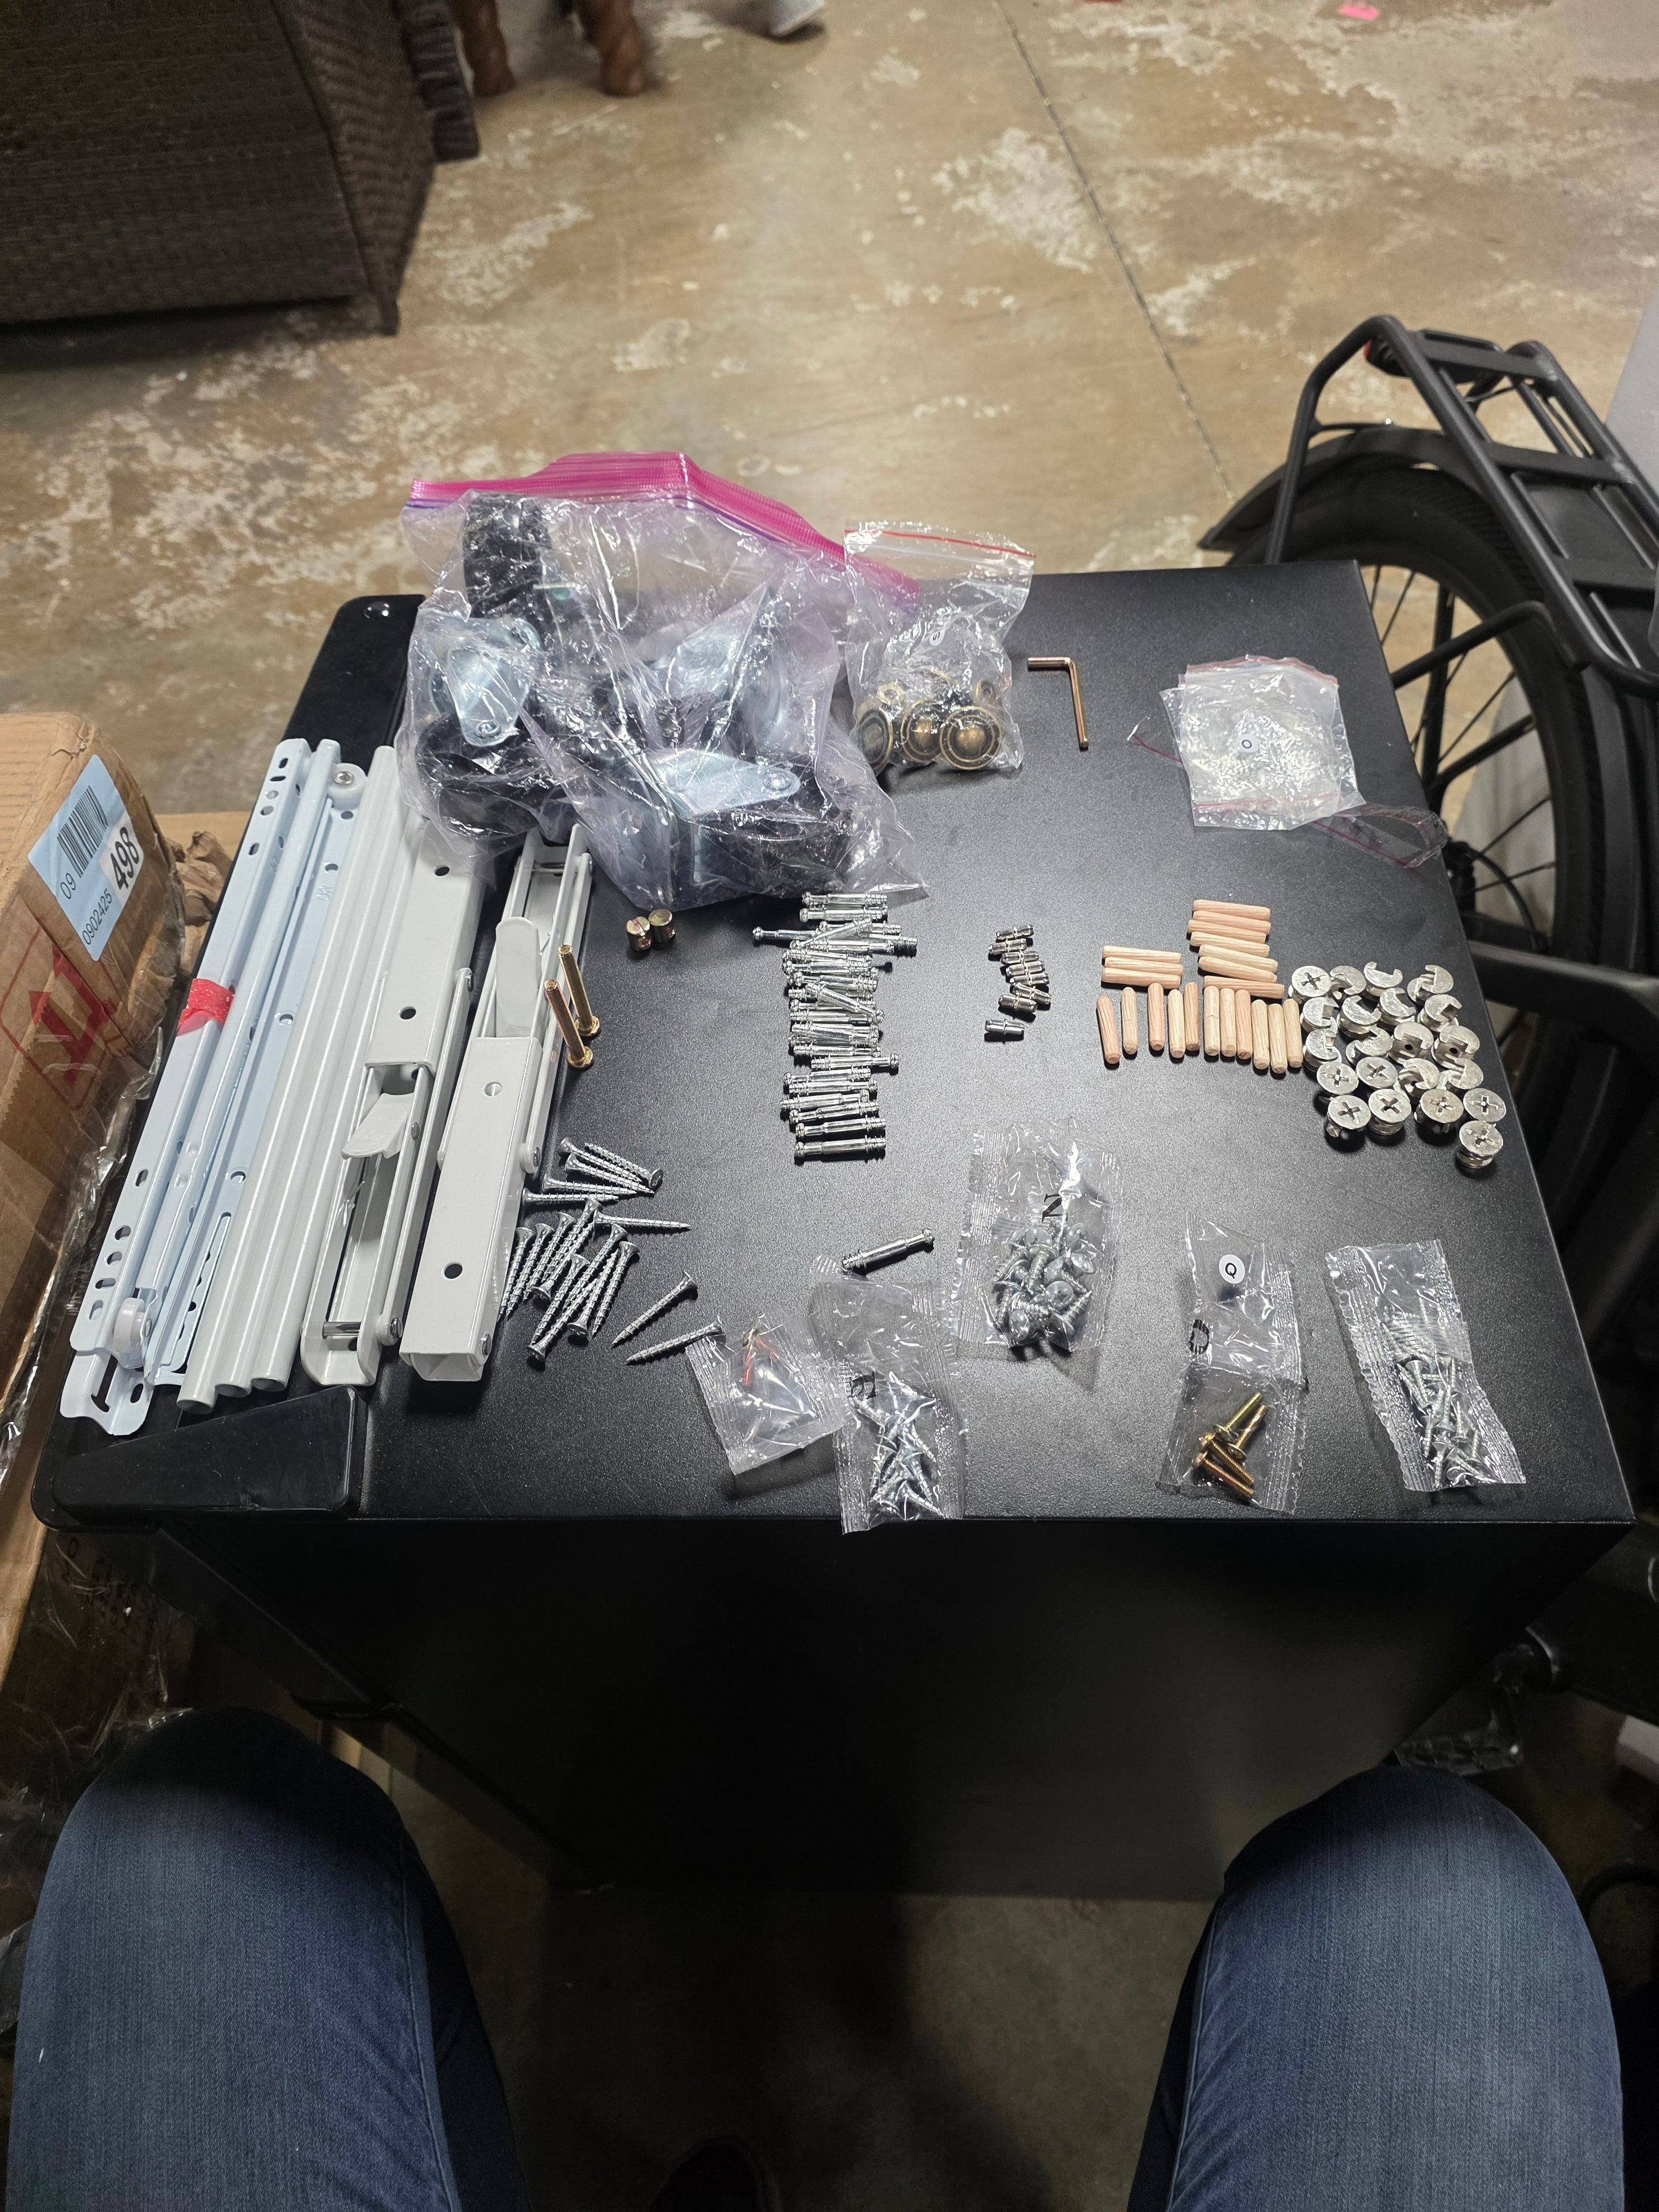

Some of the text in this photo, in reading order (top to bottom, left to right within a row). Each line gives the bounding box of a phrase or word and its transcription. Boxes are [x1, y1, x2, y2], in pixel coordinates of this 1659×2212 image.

[111, 827, 139, 890] 498
[60, 873, 76, 900] 09
[82, 888, 112, 945] 0902425
[1225, 1262, 1237, 1279] Q
